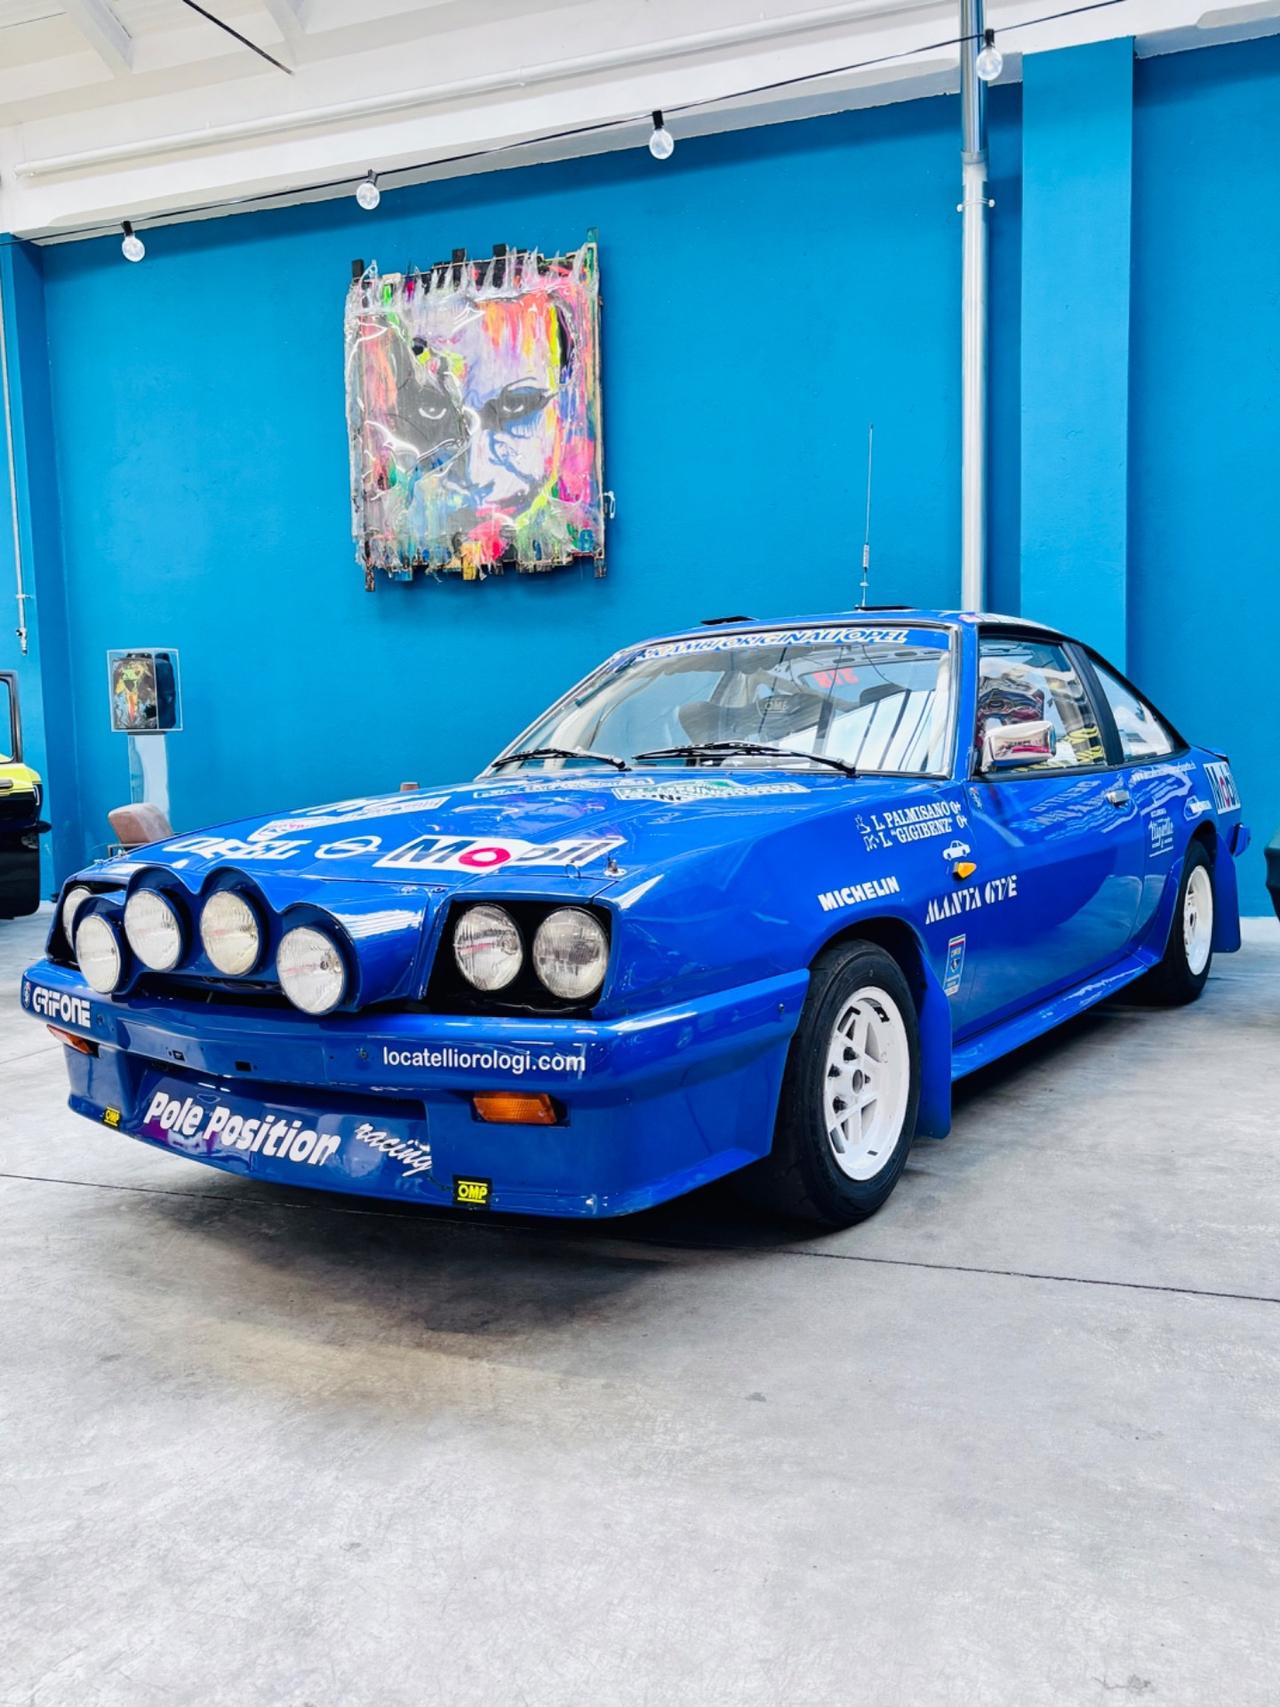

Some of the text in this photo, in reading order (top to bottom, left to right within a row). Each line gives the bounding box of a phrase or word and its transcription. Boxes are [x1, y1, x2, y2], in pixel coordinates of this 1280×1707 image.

[843, 629, 909, 643] OPEL
[883, 801, 950, 828] PALMISANO
[817, 876, 901, 912] MICHELIN
[925, 885, 981, 925] MANTA
[32, 986, 91, 1029] GRIFONE
[383, 1046, 586, 1075] locatelliorologi.com
[144, 1092, 342, 1167] Pole Position
[354, 1122, 433, 1178] racing
[458, 1184, 488, 1200] OMP
